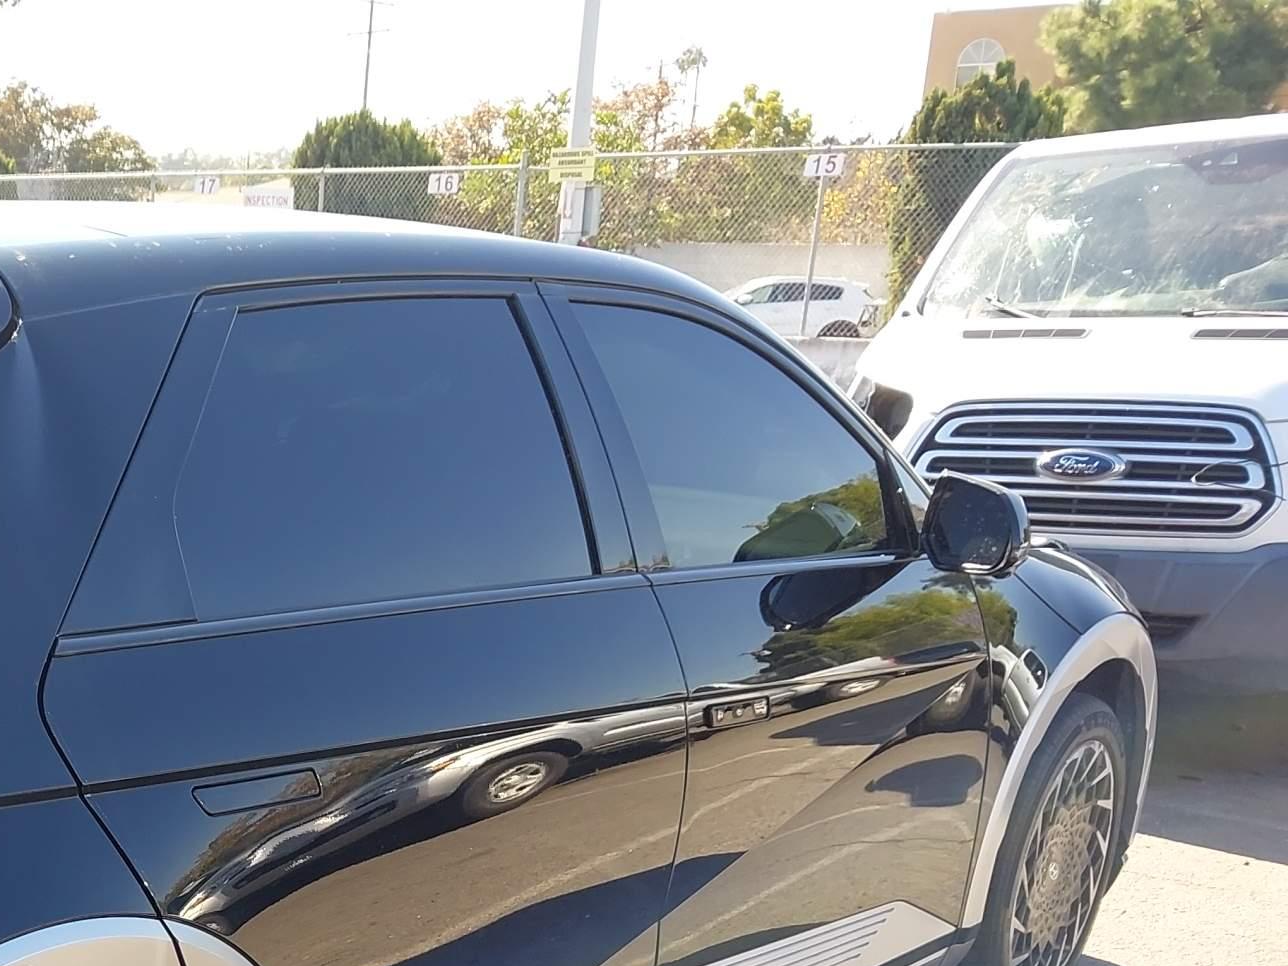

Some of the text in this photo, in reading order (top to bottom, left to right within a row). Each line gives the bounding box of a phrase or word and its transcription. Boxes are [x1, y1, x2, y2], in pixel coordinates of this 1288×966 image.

[813, 155, 837, 174] 15
[200, 176, 217, 195] 17
[435, 175, 454, 192] 16
[1053, 456, 1101, 474] Ford
